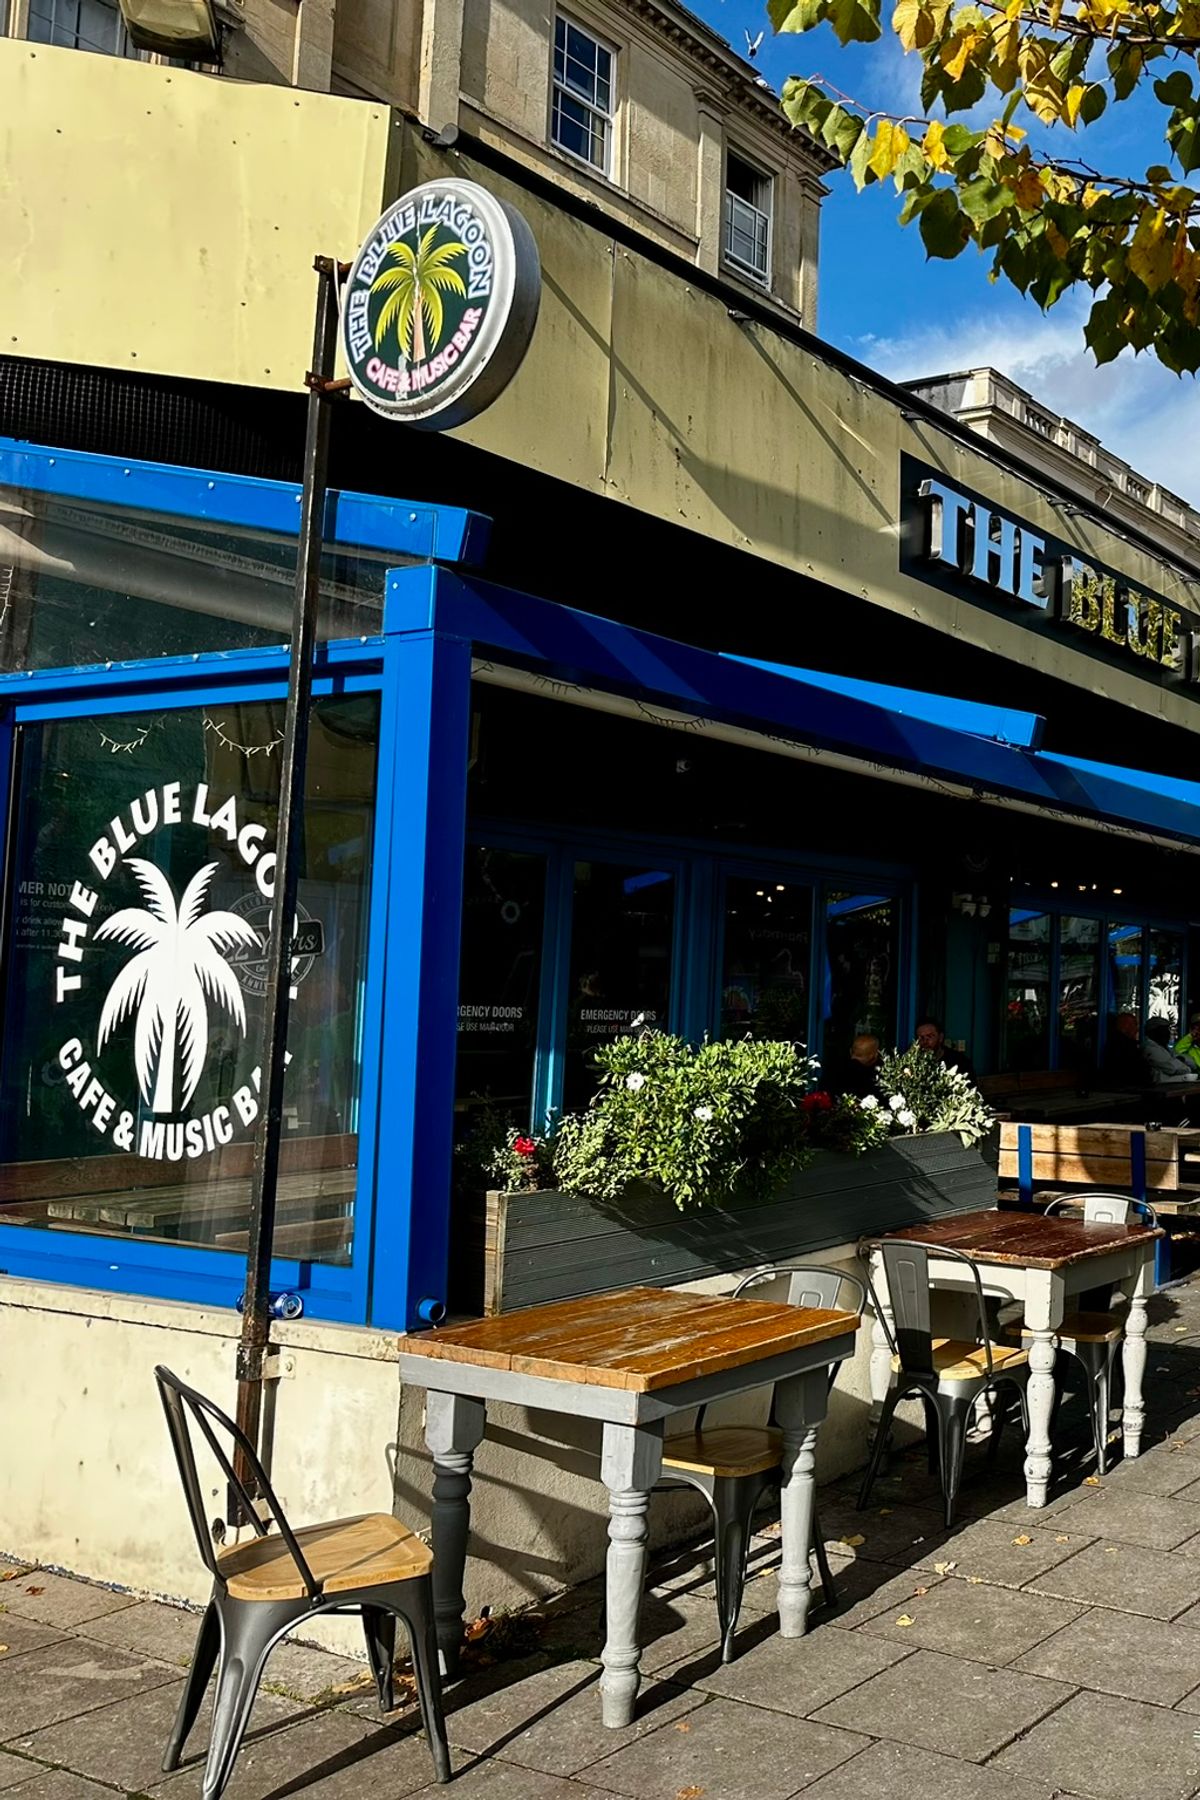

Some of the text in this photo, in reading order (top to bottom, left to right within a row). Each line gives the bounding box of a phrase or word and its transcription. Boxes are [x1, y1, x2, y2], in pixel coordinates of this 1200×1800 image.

[350, 193, 493, 364] THE BLUE LAGOON
[366, 357, 398, 392] CAFE
[411, 343, 459, 391] MUSIC
[454, 307, 483, 354] BAR
[918, 478, 1050, 610] THE
[1061, 555, 1184, 673] BLUE
[57, 879, 99, 1002] THE
[88, 781, 181, 880] BLUE
[457, 1005, 523, 1019] GENCY DOORS
[580, 1009, 629, 1021] EMERGENCY
[58, 1037, 234, 1162] CAFE & MUSIC
